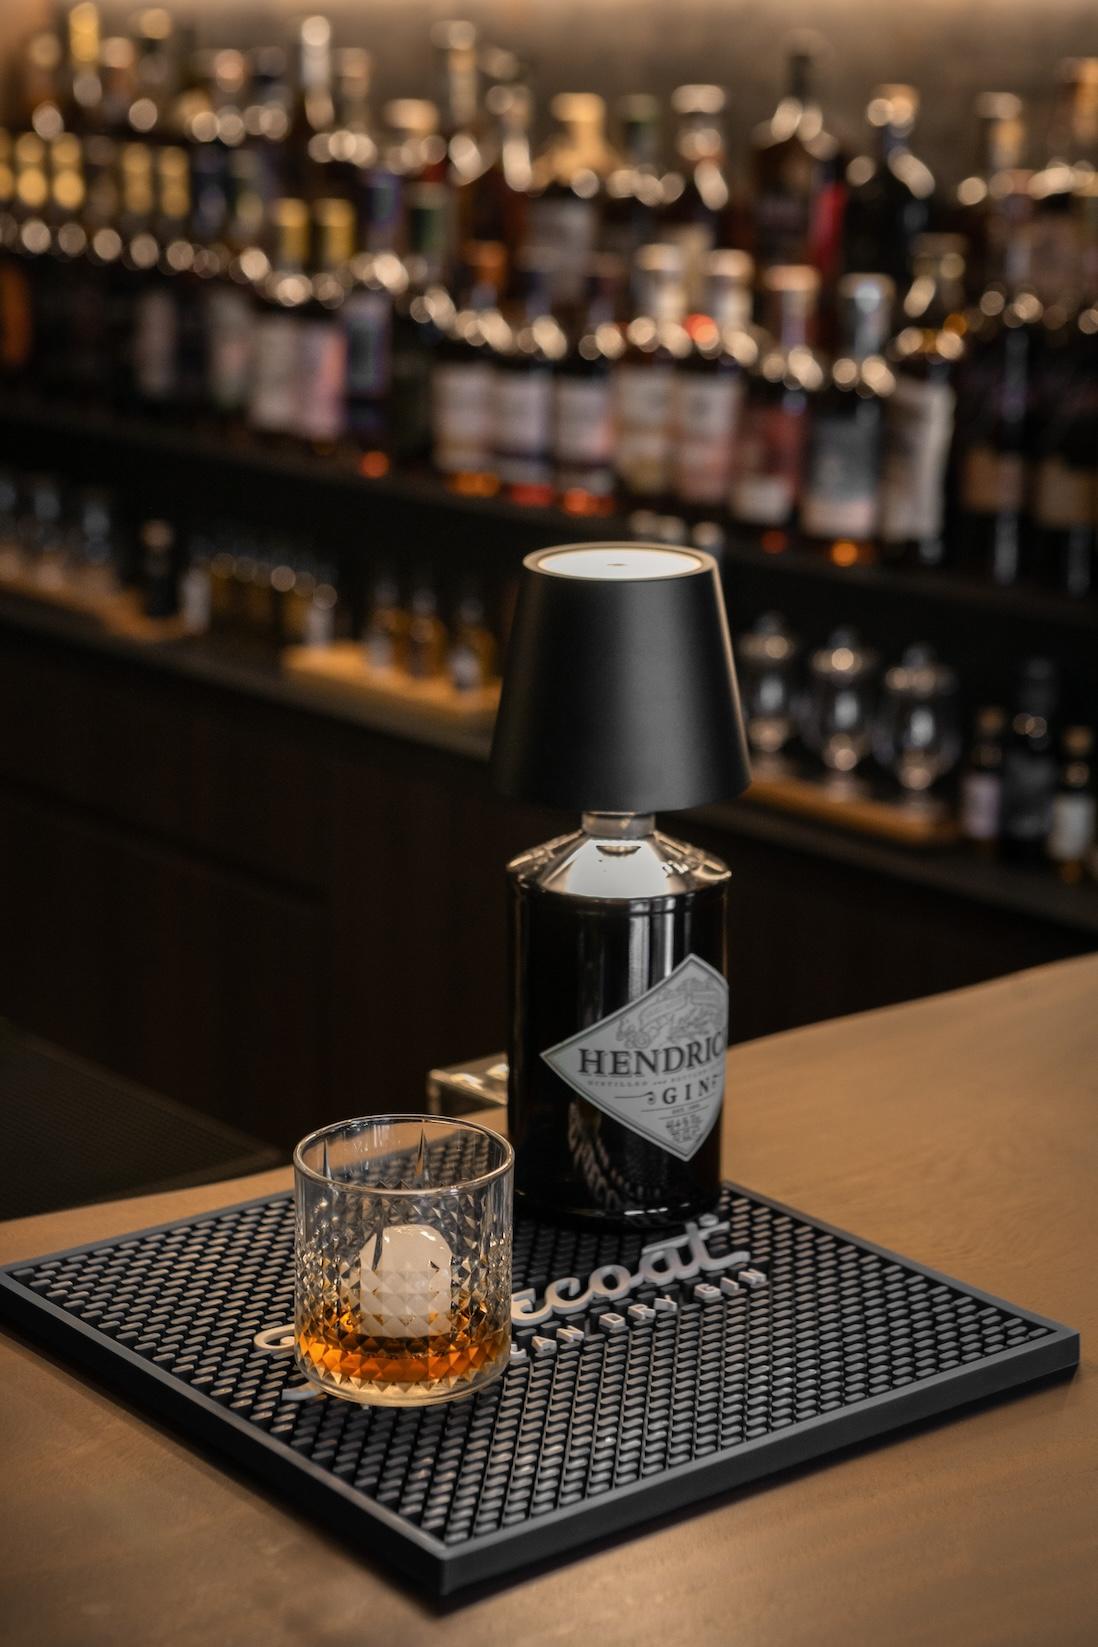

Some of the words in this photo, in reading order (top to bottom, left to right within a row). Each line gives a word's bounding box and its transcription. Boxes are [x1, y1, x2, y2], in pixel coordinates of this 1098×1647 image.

[662, 1079, 710, 1105] GIN
[599, 1295, 677, 1328] DRY
[694, 1268, 767, 1300] GIN
